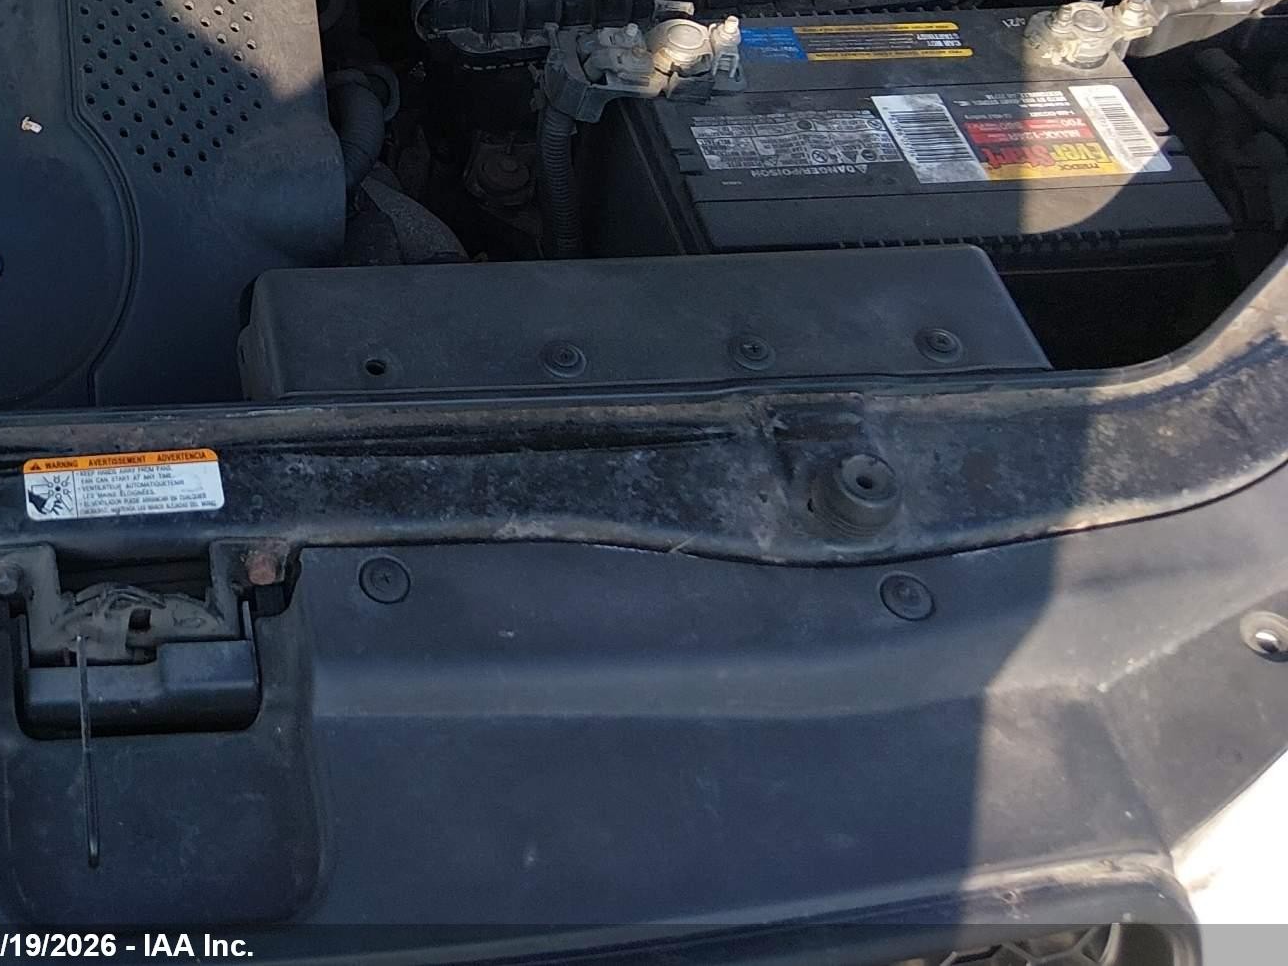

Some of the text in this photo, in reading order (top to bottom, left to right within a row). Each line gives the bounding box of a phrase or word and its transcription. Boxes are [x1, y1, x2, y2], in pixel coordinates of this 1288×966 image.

[45, 451, 206, 470] WARNING AVERTISSEMENT ADVERTENCIA
